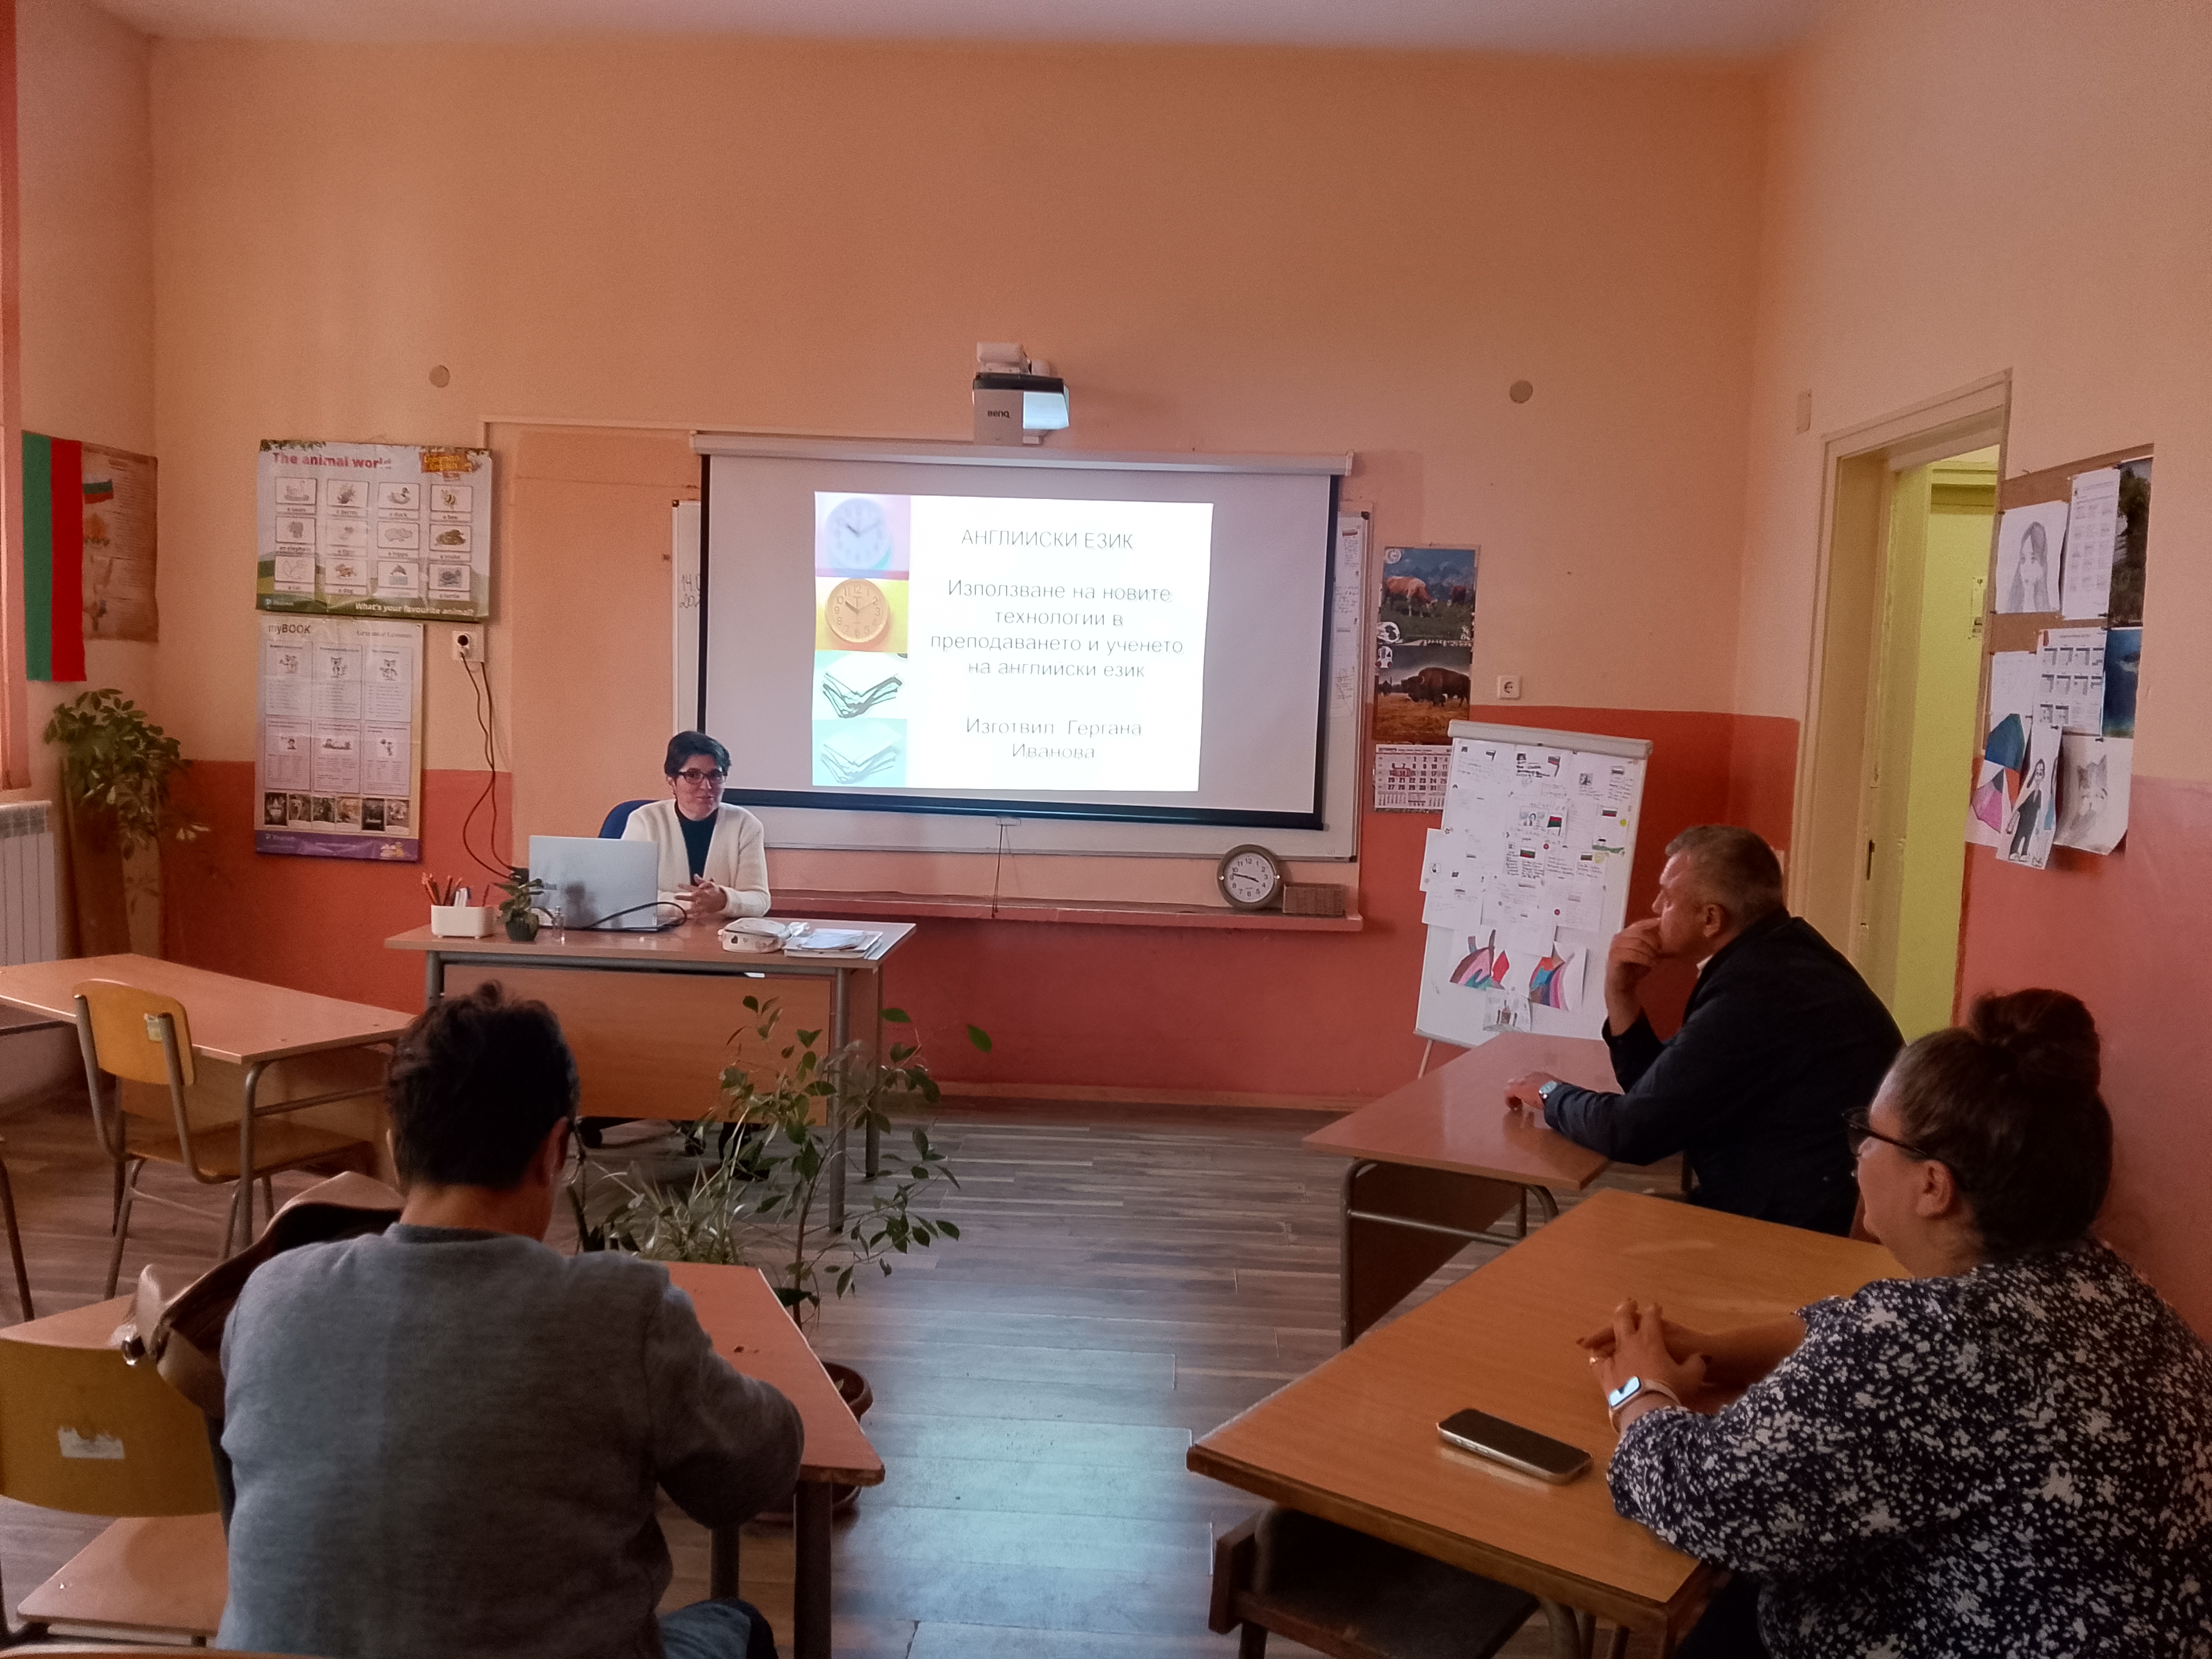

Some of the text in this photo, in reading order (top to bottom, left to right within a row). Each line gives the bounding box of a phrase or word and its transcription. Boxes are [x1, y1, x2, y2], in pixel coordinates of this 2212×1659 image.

[273, 453, 298, 464] The
[302, 455, 348, 467] animal
[1084, 532, 1134, 549] ЕЗИК
[853, 584, 861, 594] 12
[949, 579, 1171, 602] Използване на новите
[355, 602, 382, 611] What's
[834, 605, 840, 614] 9
[874, 607, 880, 616] 3
[995, 611, 1123, 626] технологии в
[854, 628, 860, 637] 6
[864, 625, 870, 634] 5
[930, 636, 1184, 656] преподаването и ученето
[968, 662, 990, 674] на
[1103, 665, 1145, 678] език
[966, 716, 1142, 738] Изготвил Гергана
[1012, 743, 1095, 759] Иванова
